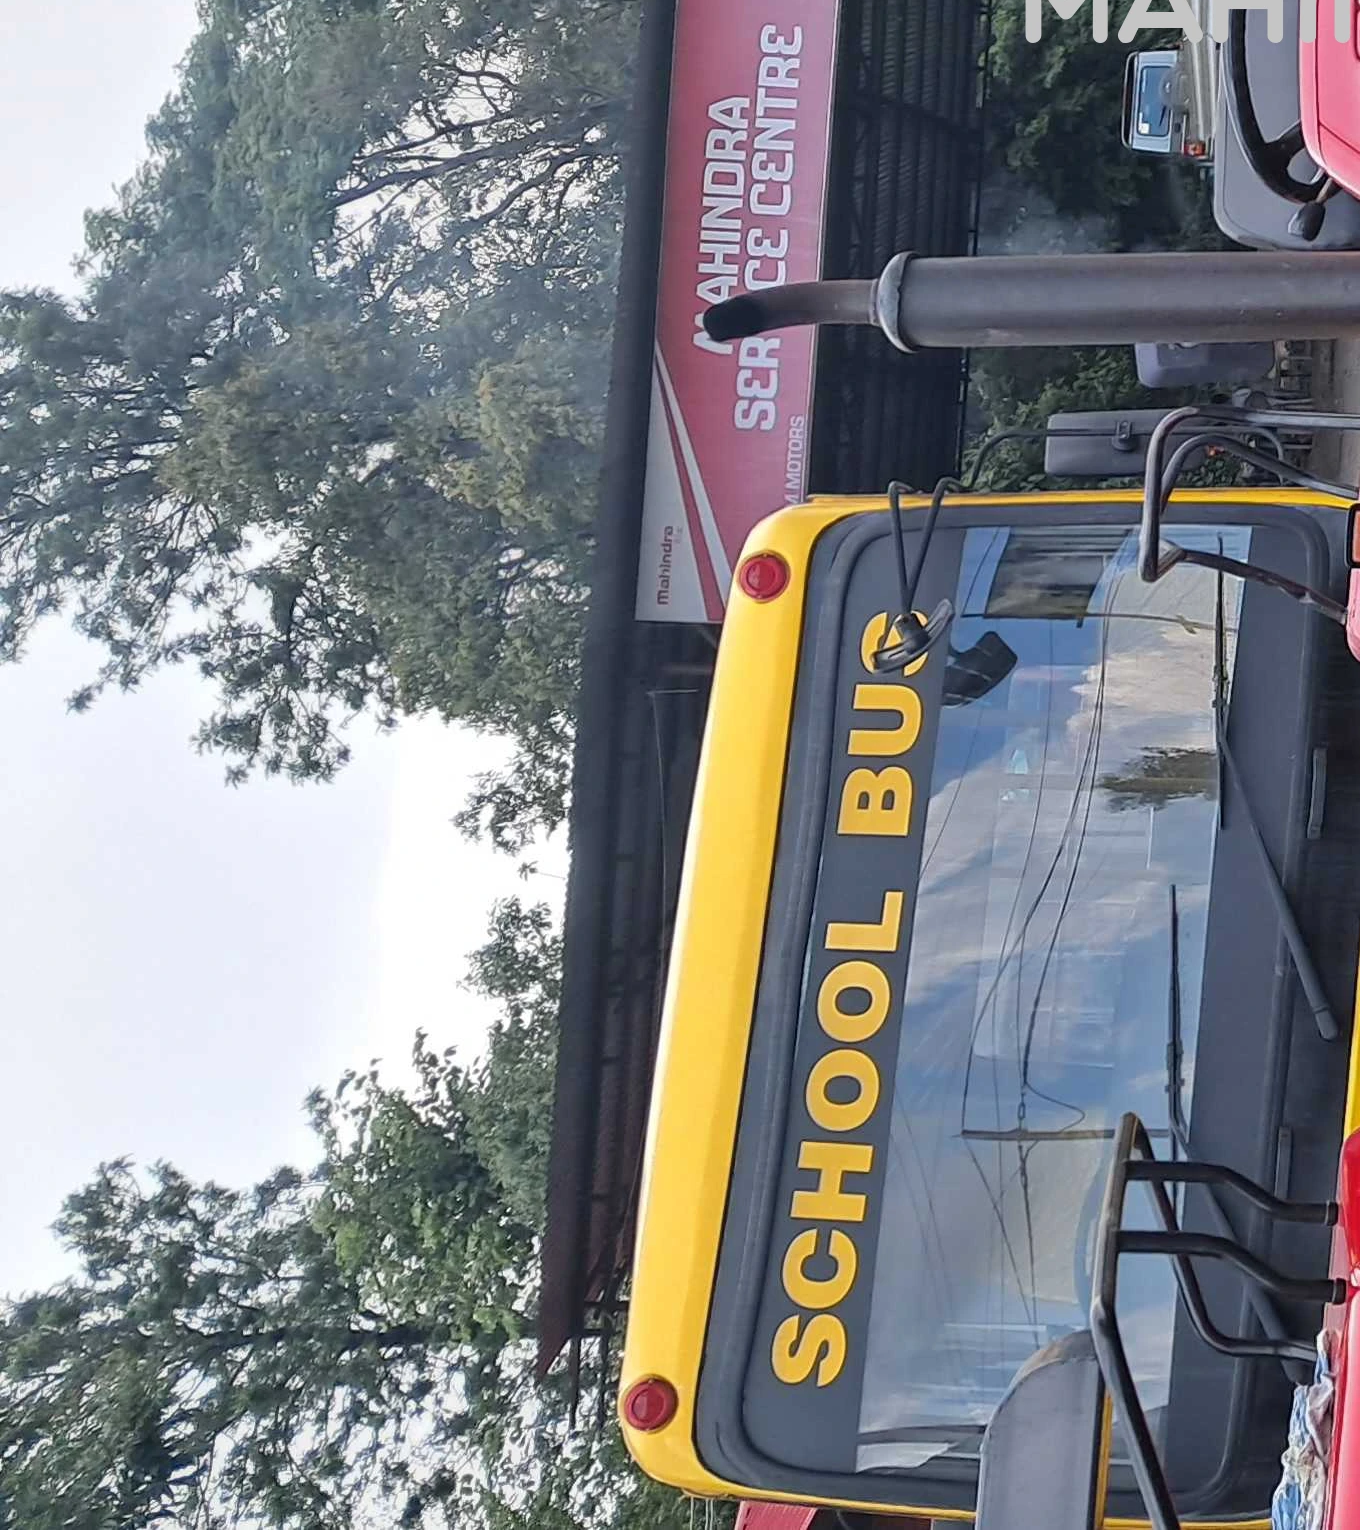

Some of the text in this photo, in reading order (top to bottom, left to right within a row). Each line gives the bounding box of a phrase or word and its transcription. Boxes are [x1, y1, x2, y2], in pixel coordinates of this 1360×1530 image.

[692, 96, 751, 355] MAHINDRA
[735, 23, 804, 431] SERCE CENTRE
[656, 526, 674, 606] Mahindra
[786, 414, 805, 490] MOTORS
[770, 609, 932, 1388] SCHOOL BUS
